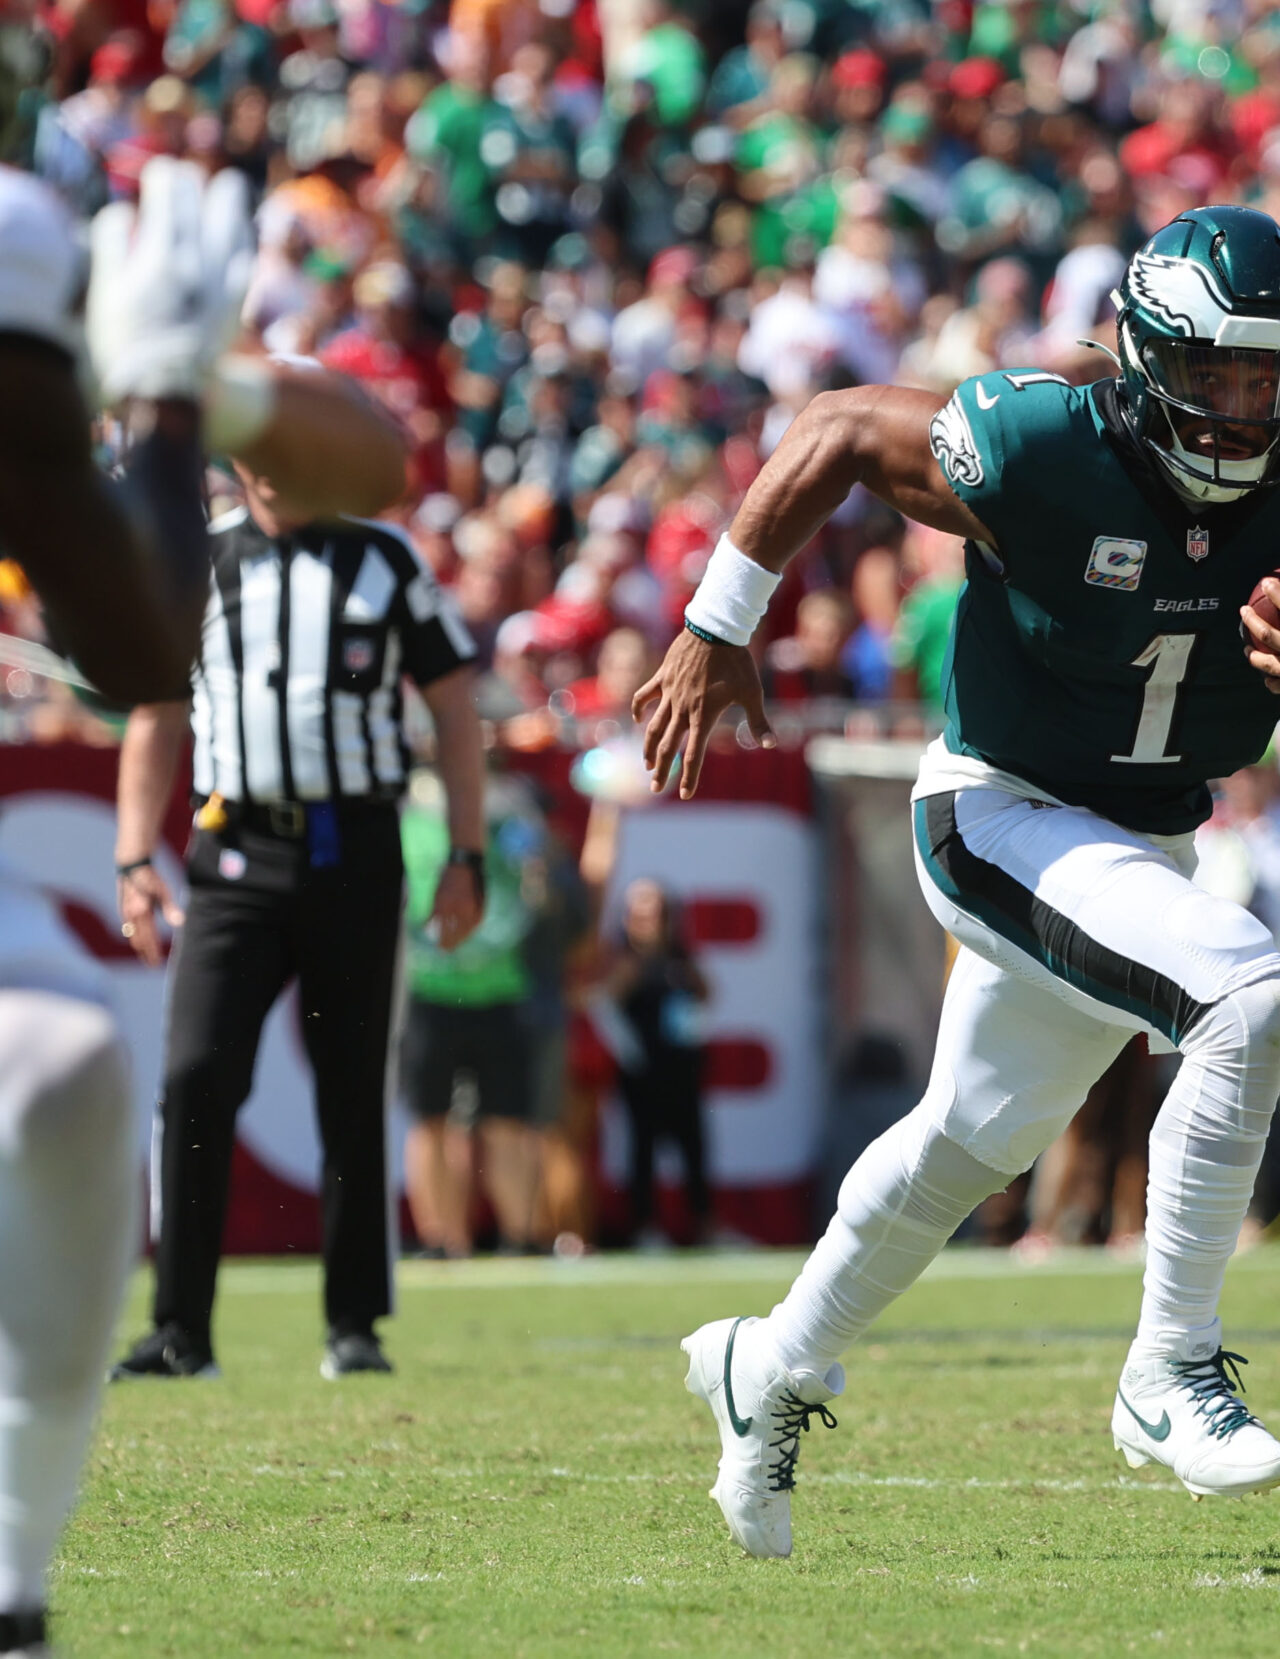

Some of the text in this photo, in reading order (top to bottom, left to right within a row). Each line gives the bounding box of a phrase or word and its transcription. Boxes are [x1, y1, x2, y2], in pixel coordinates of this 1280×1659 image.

[1094, 541, 1144, 577] C
[1189, 541, 1206, 557] NFL
[1153, 598, 1220, 613] EAGLES
[1110, 633, 1197, 764] 1
